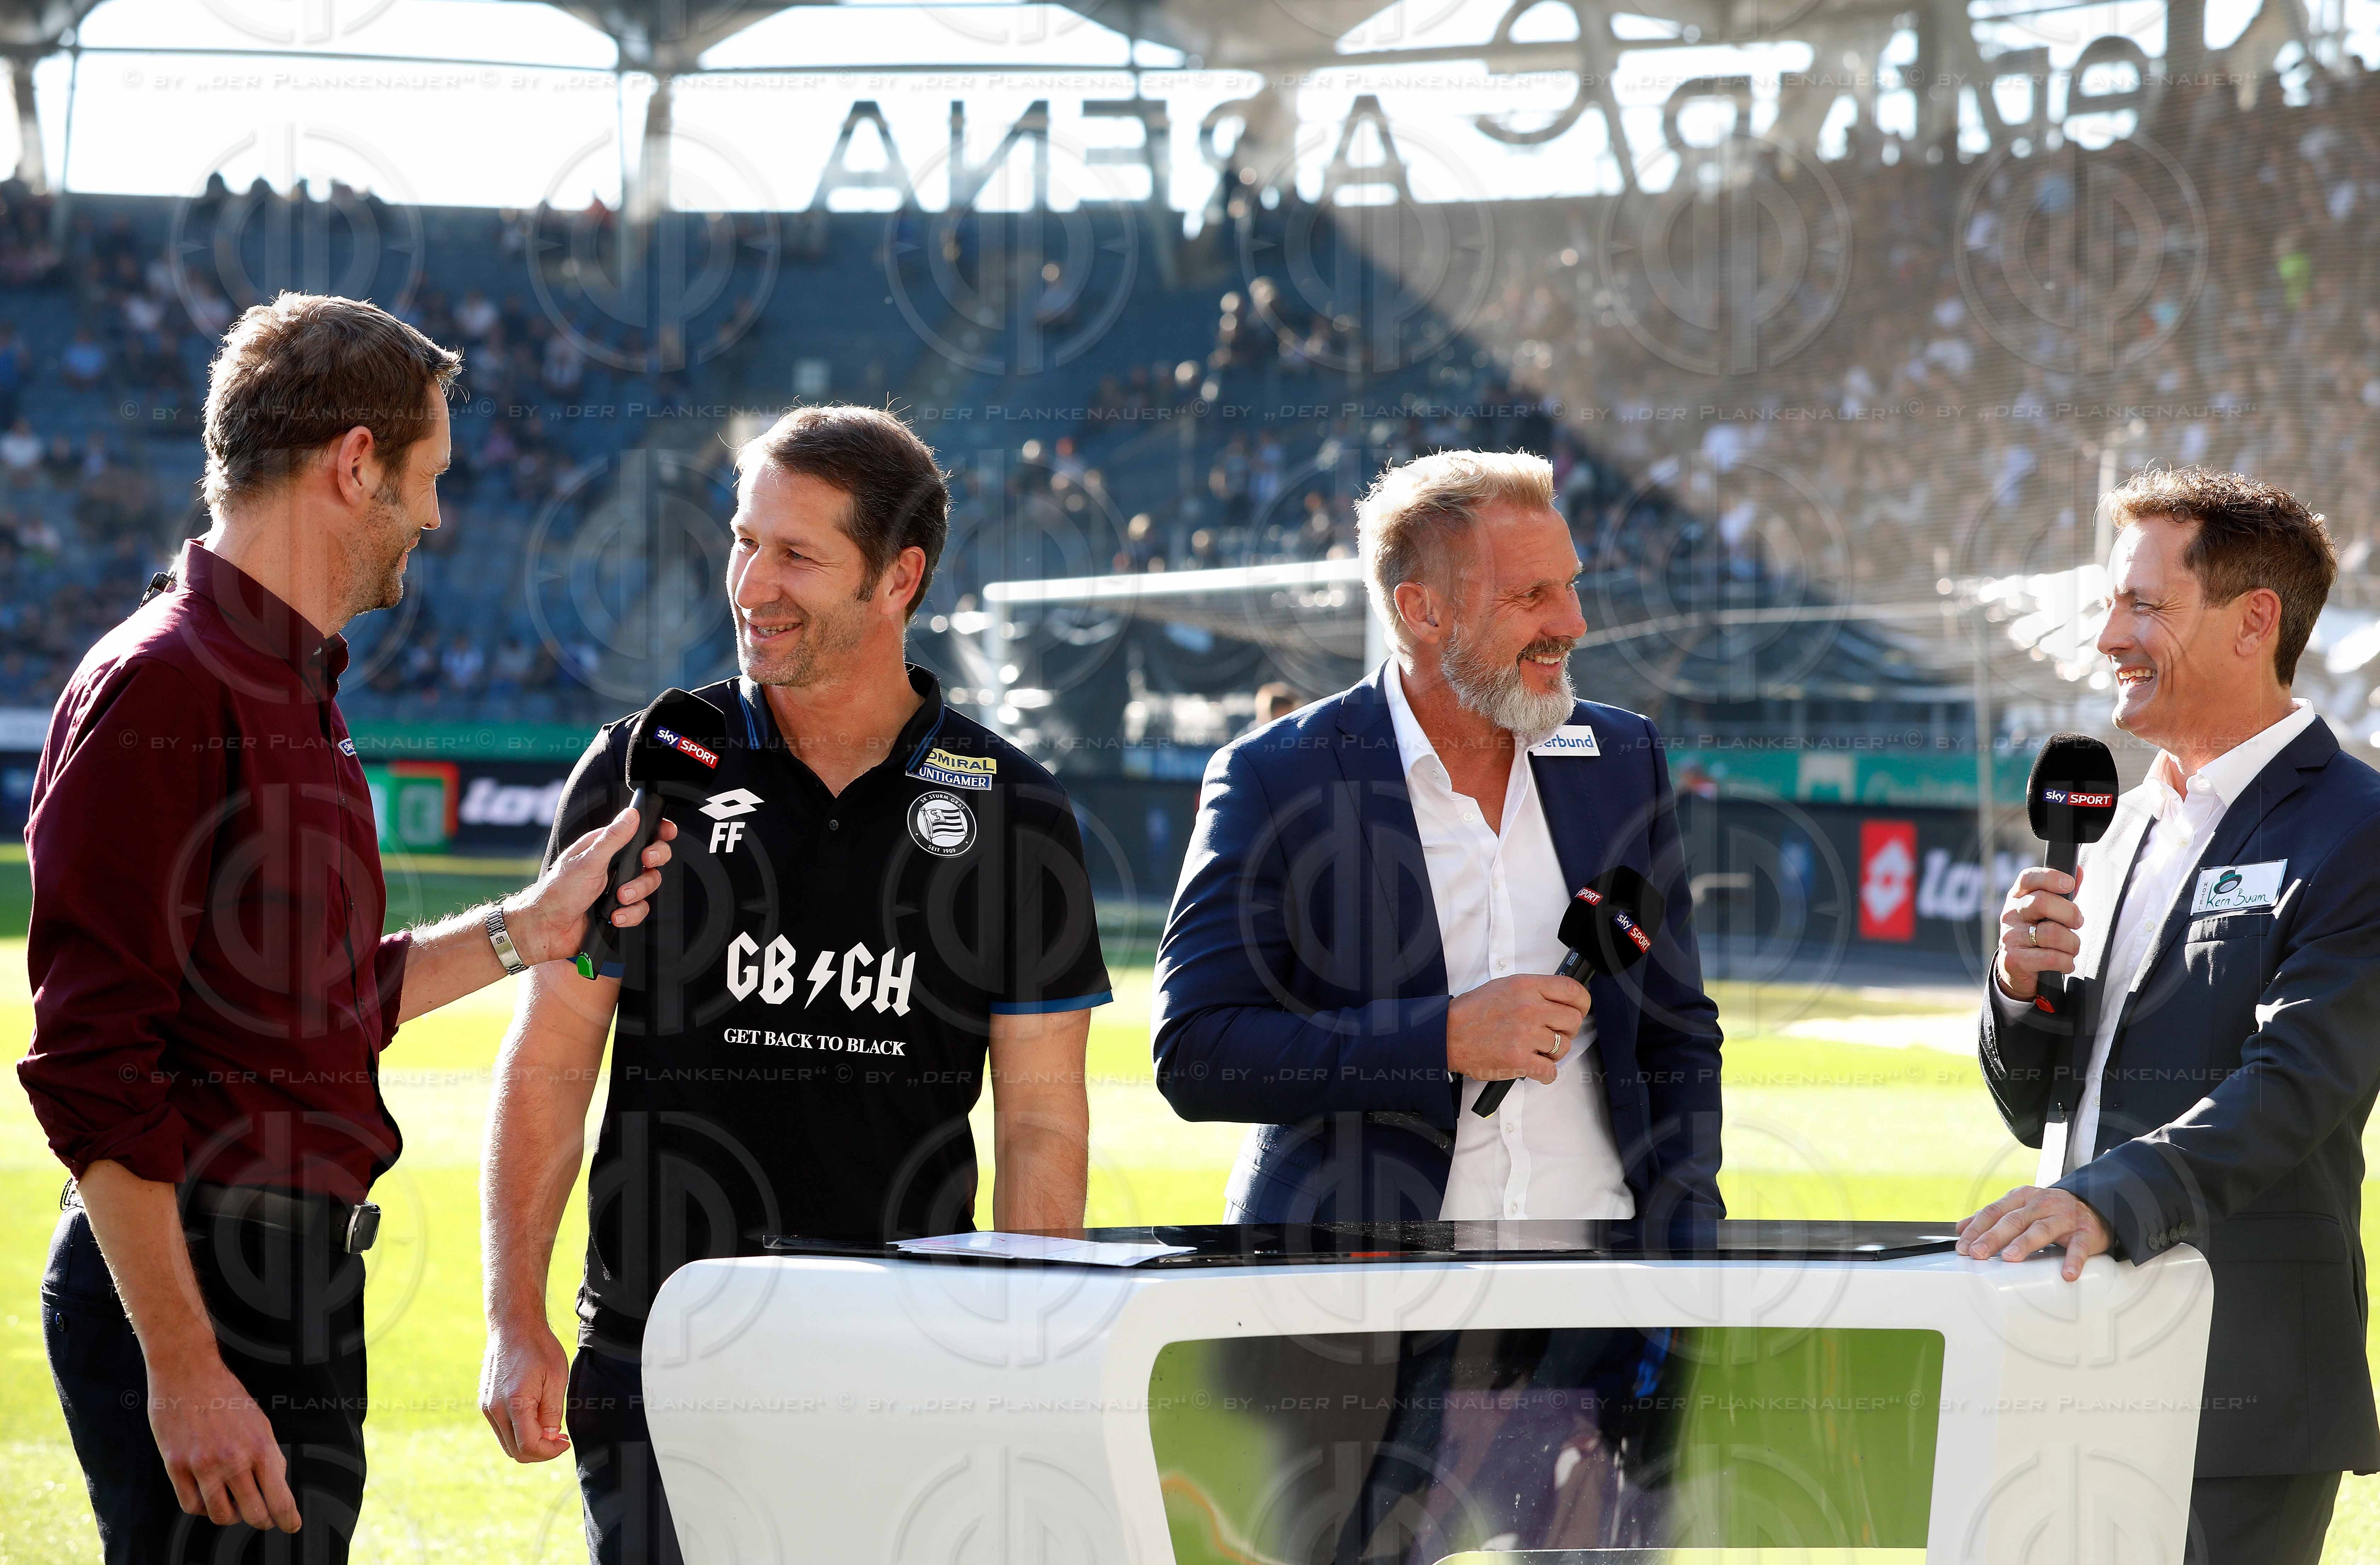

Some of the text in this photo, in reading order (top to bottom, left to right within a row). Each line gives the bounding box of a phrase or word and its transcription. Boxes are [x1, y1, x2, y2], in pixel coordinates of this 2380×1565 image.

[657, 729, 717, 764] sky SPORT
[1538, 734, 1594, 747] erbund
[919, 767, 986, 787] UNTIGAMER
[951, 798, 966, 811] GRAZ
[2046, 790, 2110, 804] sky SPORT
[709, 822, 745, 853] FF
[928, 844, 940, 853] SEIT
[1579, 889, 1600, 902] SPORT
[2198, 882, 2208, 910] HOTEL
[1617, 914, 1650, 950] sky SPORT
[724, 1028, 906, 1057] GET BACK TO BLACK
